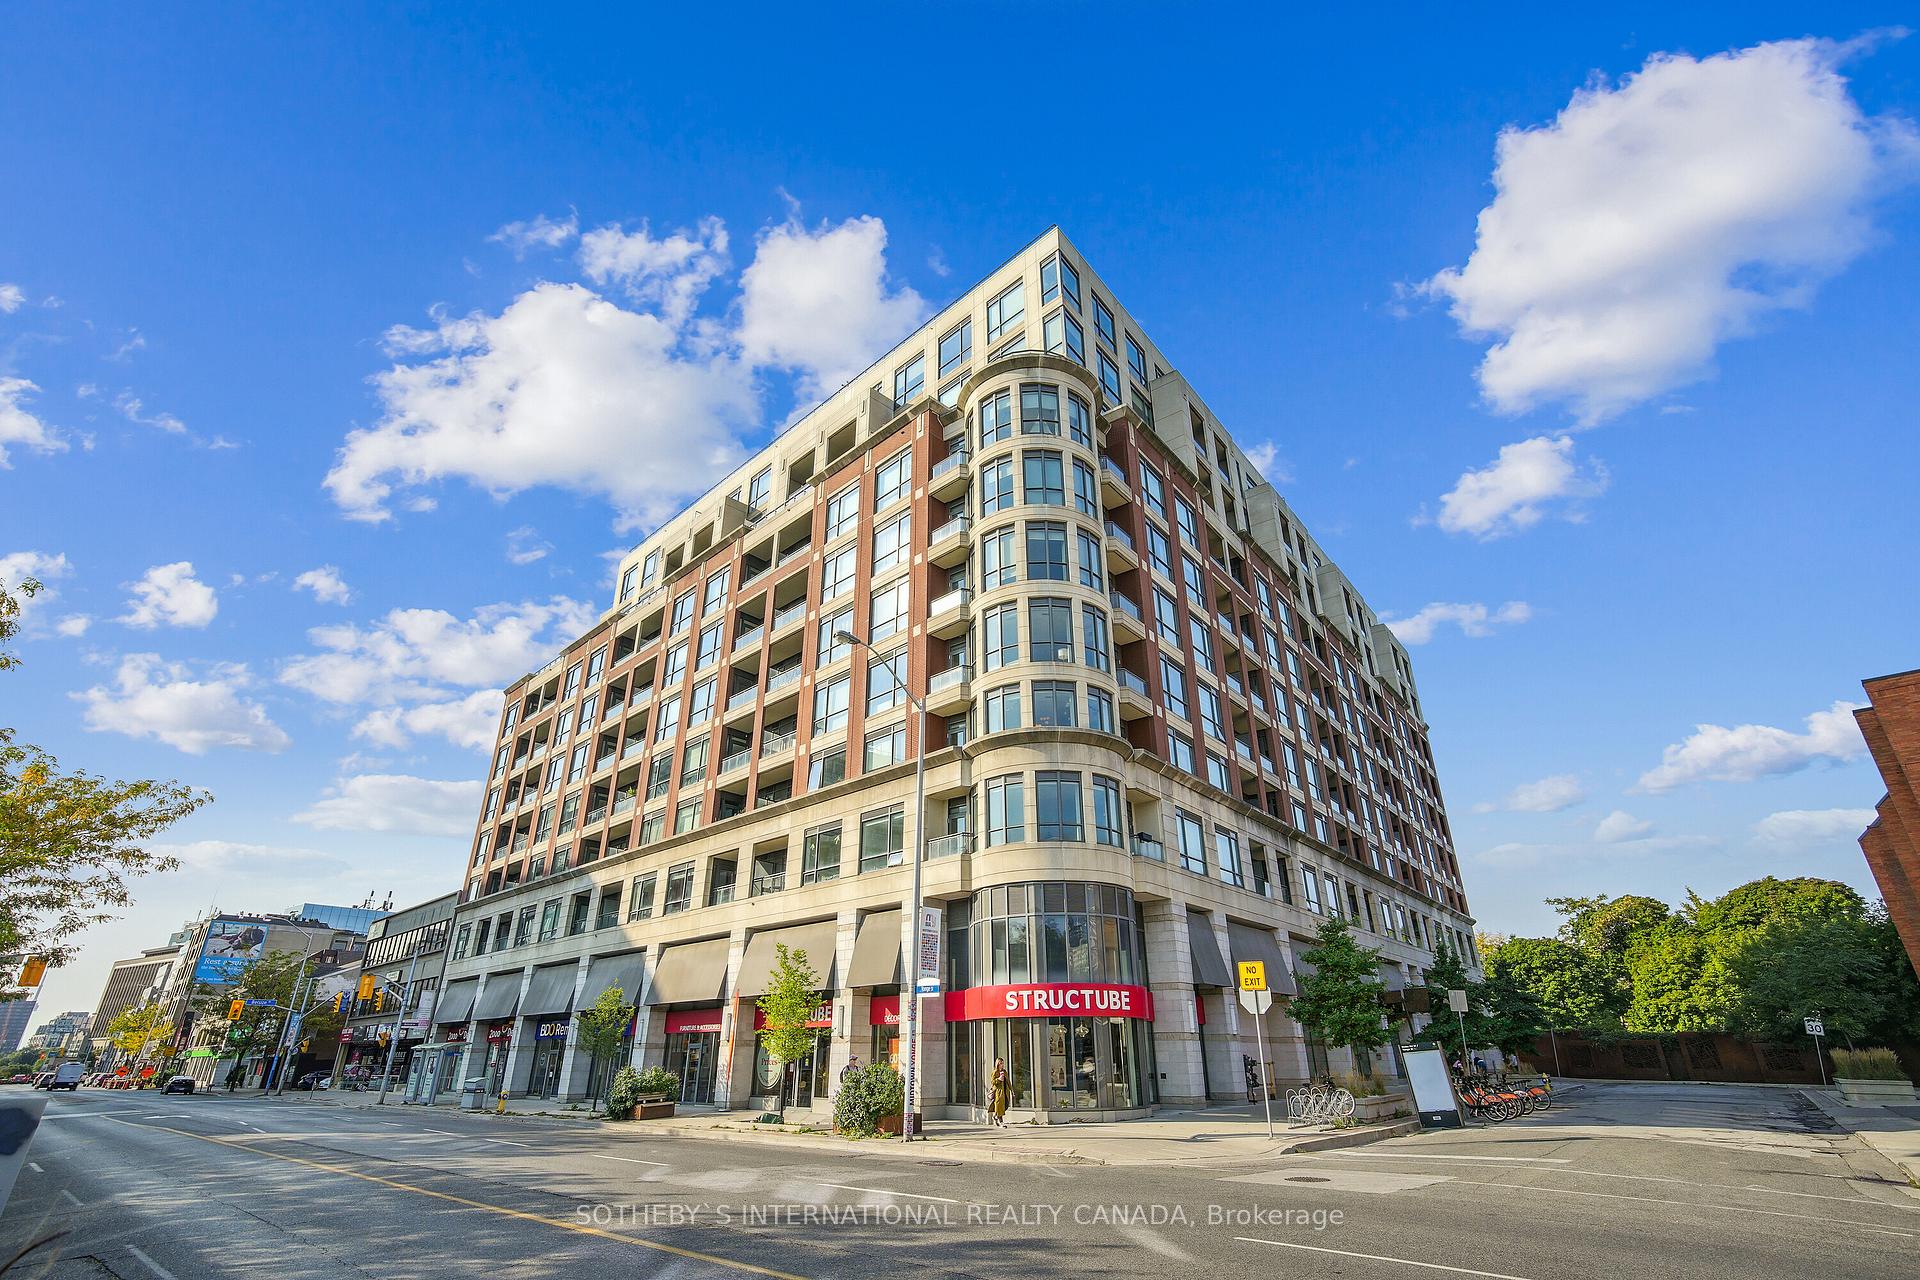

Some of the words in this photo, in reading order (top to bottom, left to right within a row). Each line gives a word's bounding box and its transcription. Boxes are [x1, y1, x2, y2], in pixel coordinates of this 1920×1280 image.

[1245, 965, 1257, 974] NO
[1244, 977, 1260, 986] EXIT
[1005, 989, 1131, 1011] STRUCTUBE
[811, 1005, 832, 1022] UBE
[540, 1023, 555, 1037] BDO
[1807, 1024, 1822, 1033] 30
[489, 1029, 501, 1038] 2000
